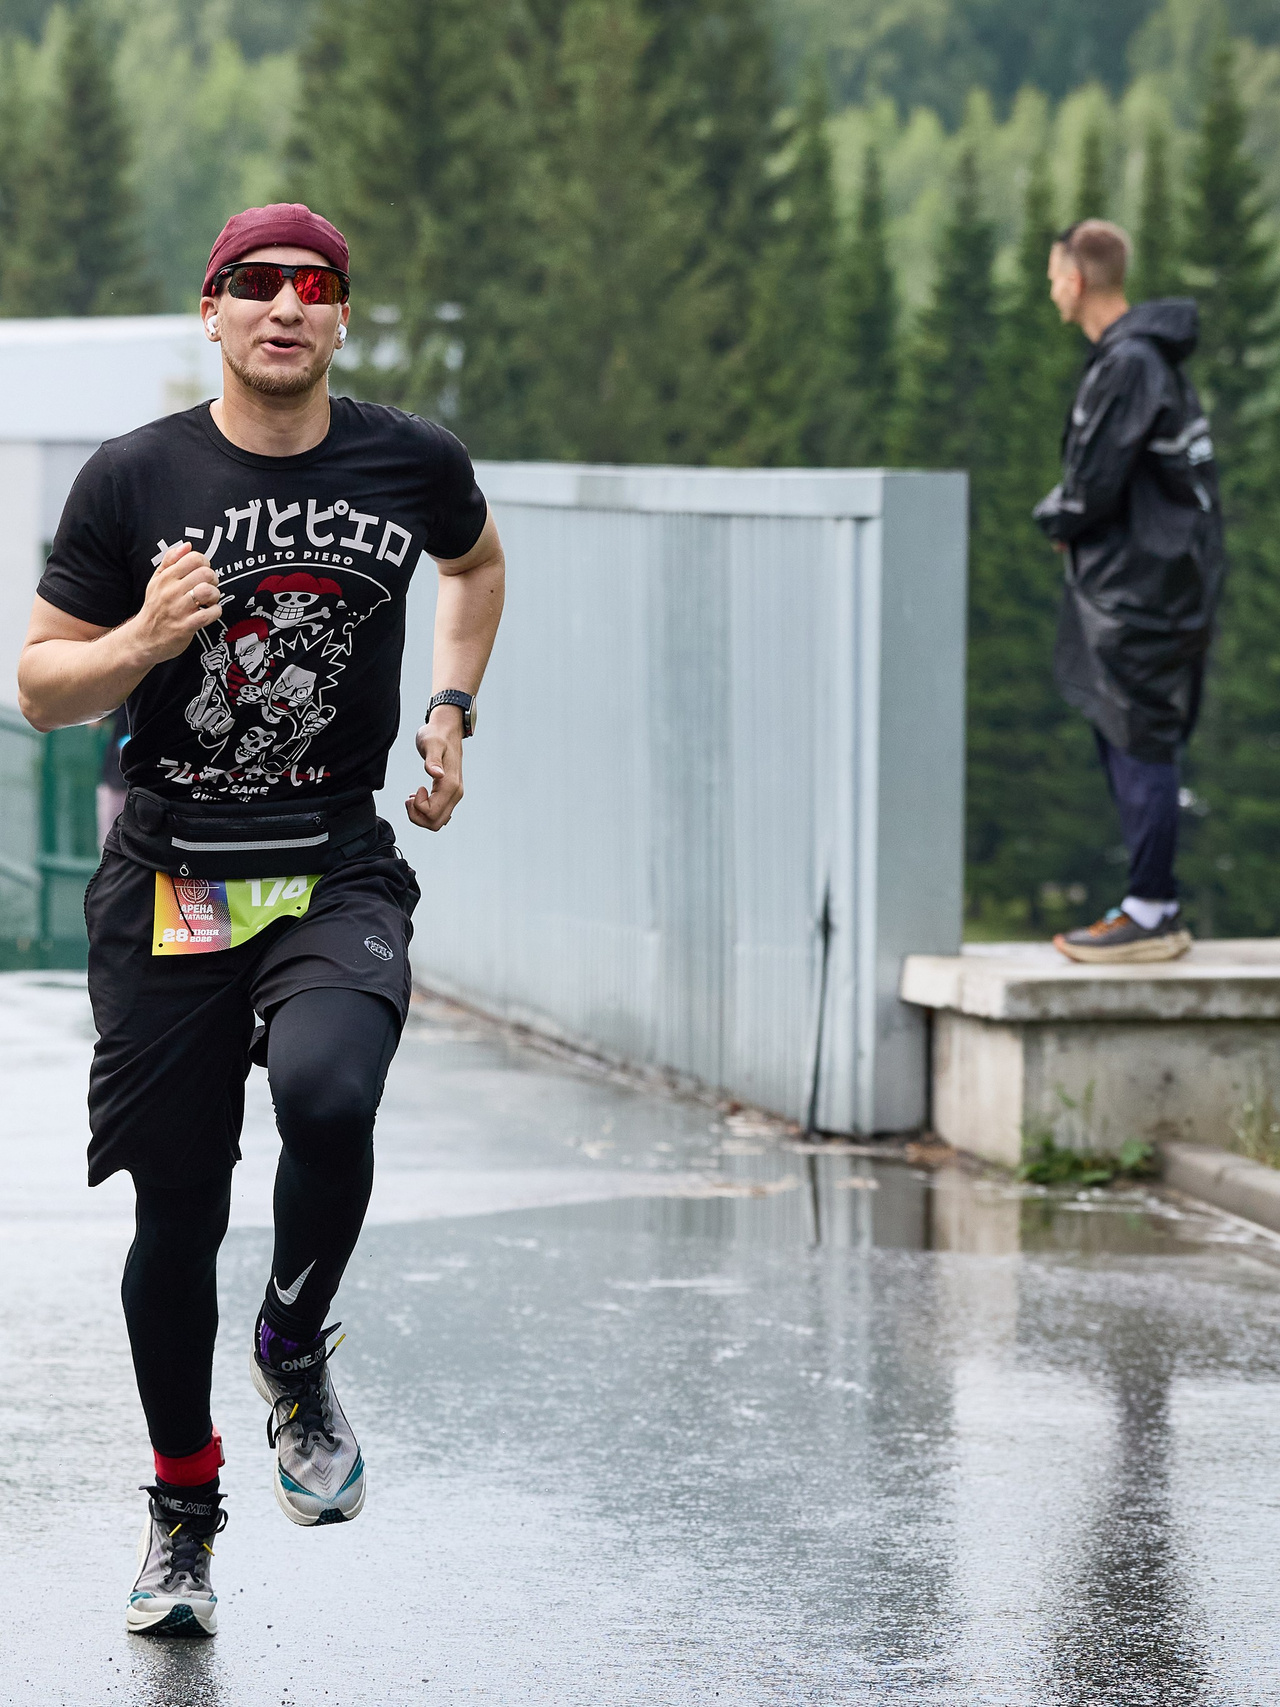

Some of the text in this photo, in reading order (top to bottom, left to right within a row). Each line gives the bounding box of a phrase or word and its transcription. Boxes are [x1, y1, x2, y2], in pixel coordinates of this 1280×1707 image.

[214, 550, 354, 577] KINGU TO PIERO
[229, 784, 270, 796] SAKE
[245, 875, 308, 907] 174
[180, 903, 214, 914] АРЕНА
[162, 928, 189, 943] 28
